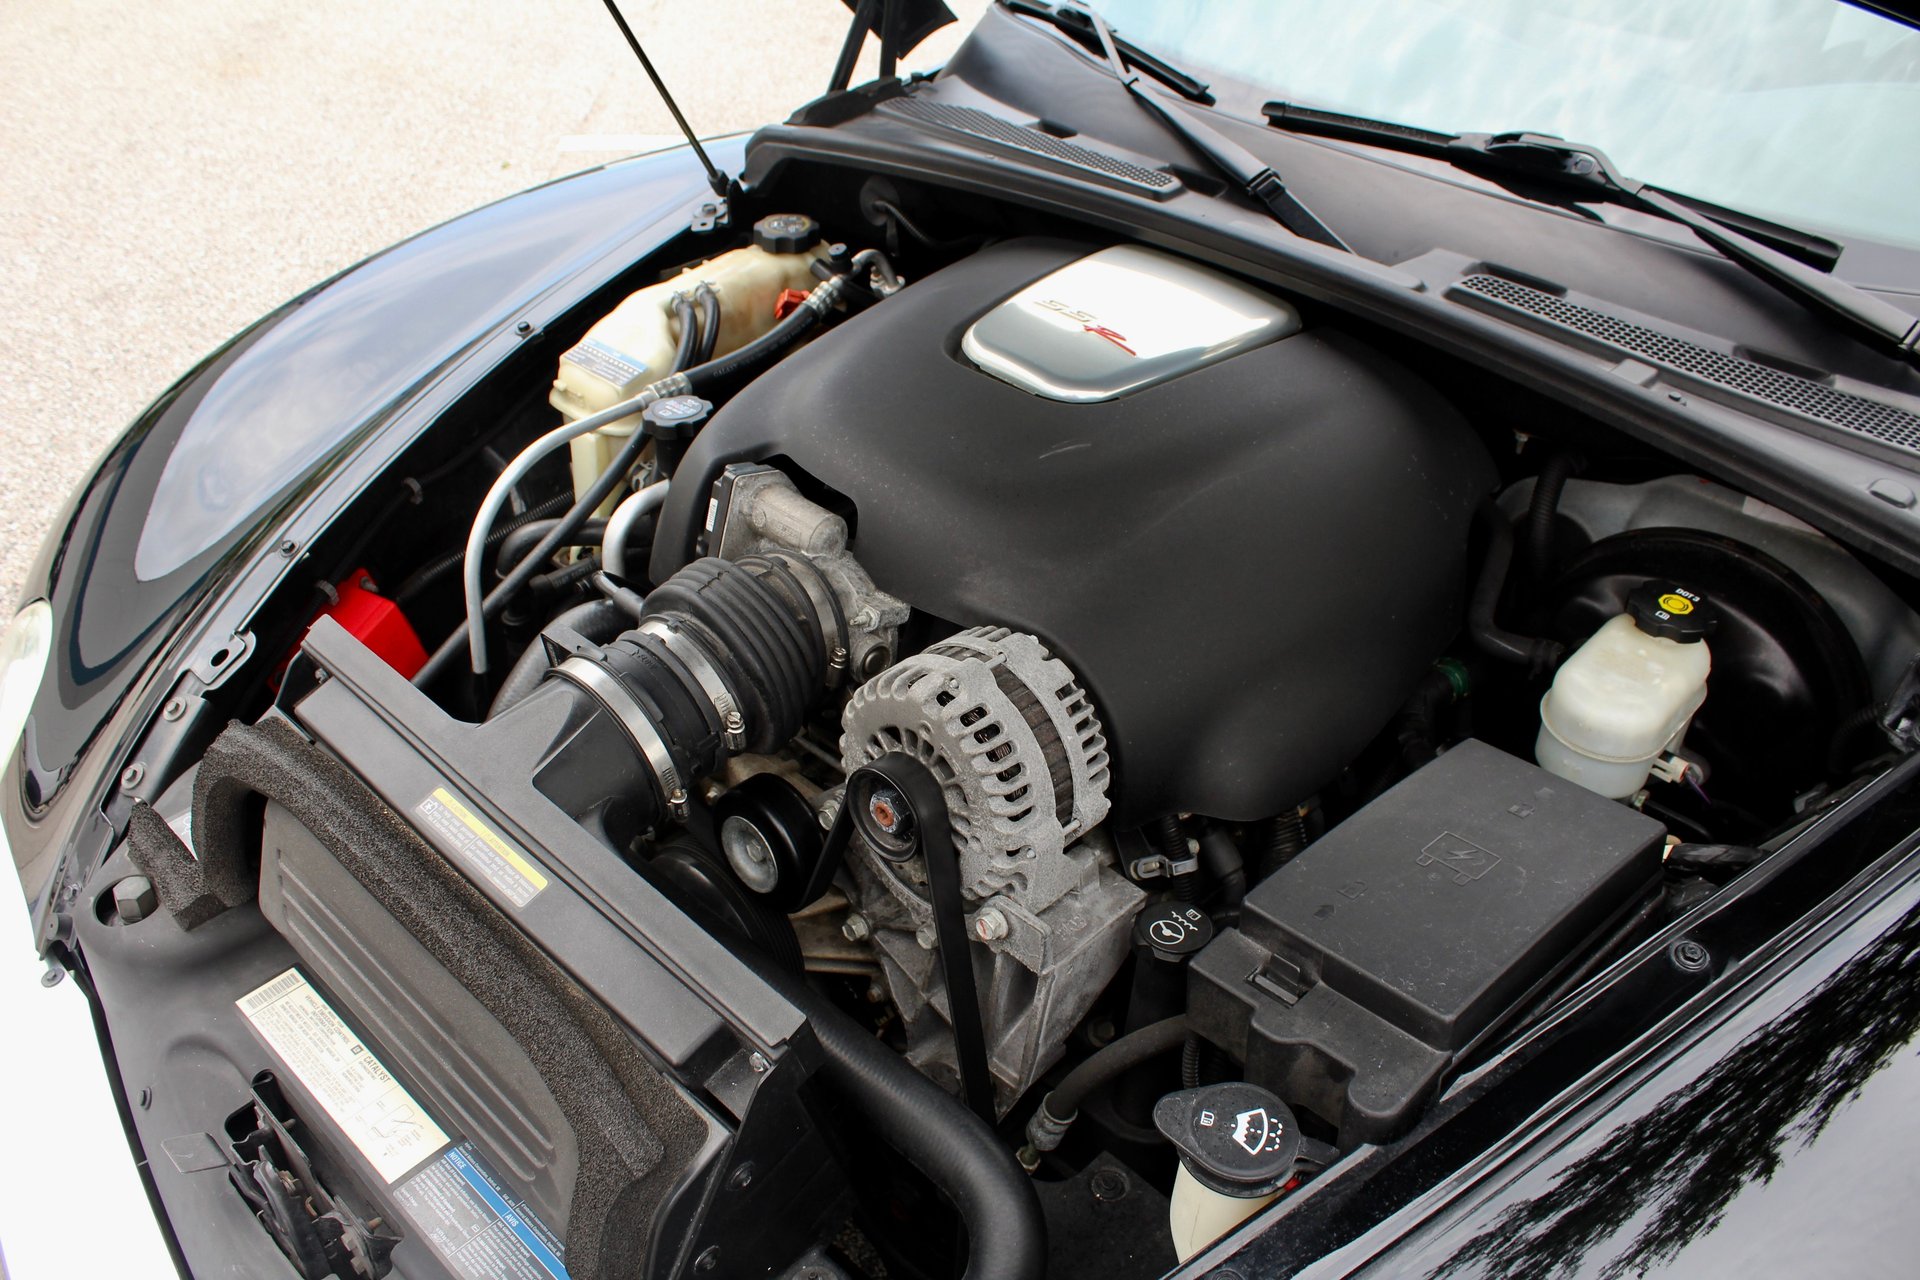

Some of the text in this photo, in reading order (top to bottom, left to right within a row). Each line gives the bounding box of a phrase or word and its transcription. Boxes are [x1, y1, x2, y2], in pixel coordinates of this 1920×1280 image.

[1034, 300, 1136, 356] SSR
[1675, 588, 1694, 599] DOT
[362, 1055, 391, 1083] CATALYST
[448, 1151, 466, 1169] NOTICE
[504, 1213, 519, 1227] AVIS
